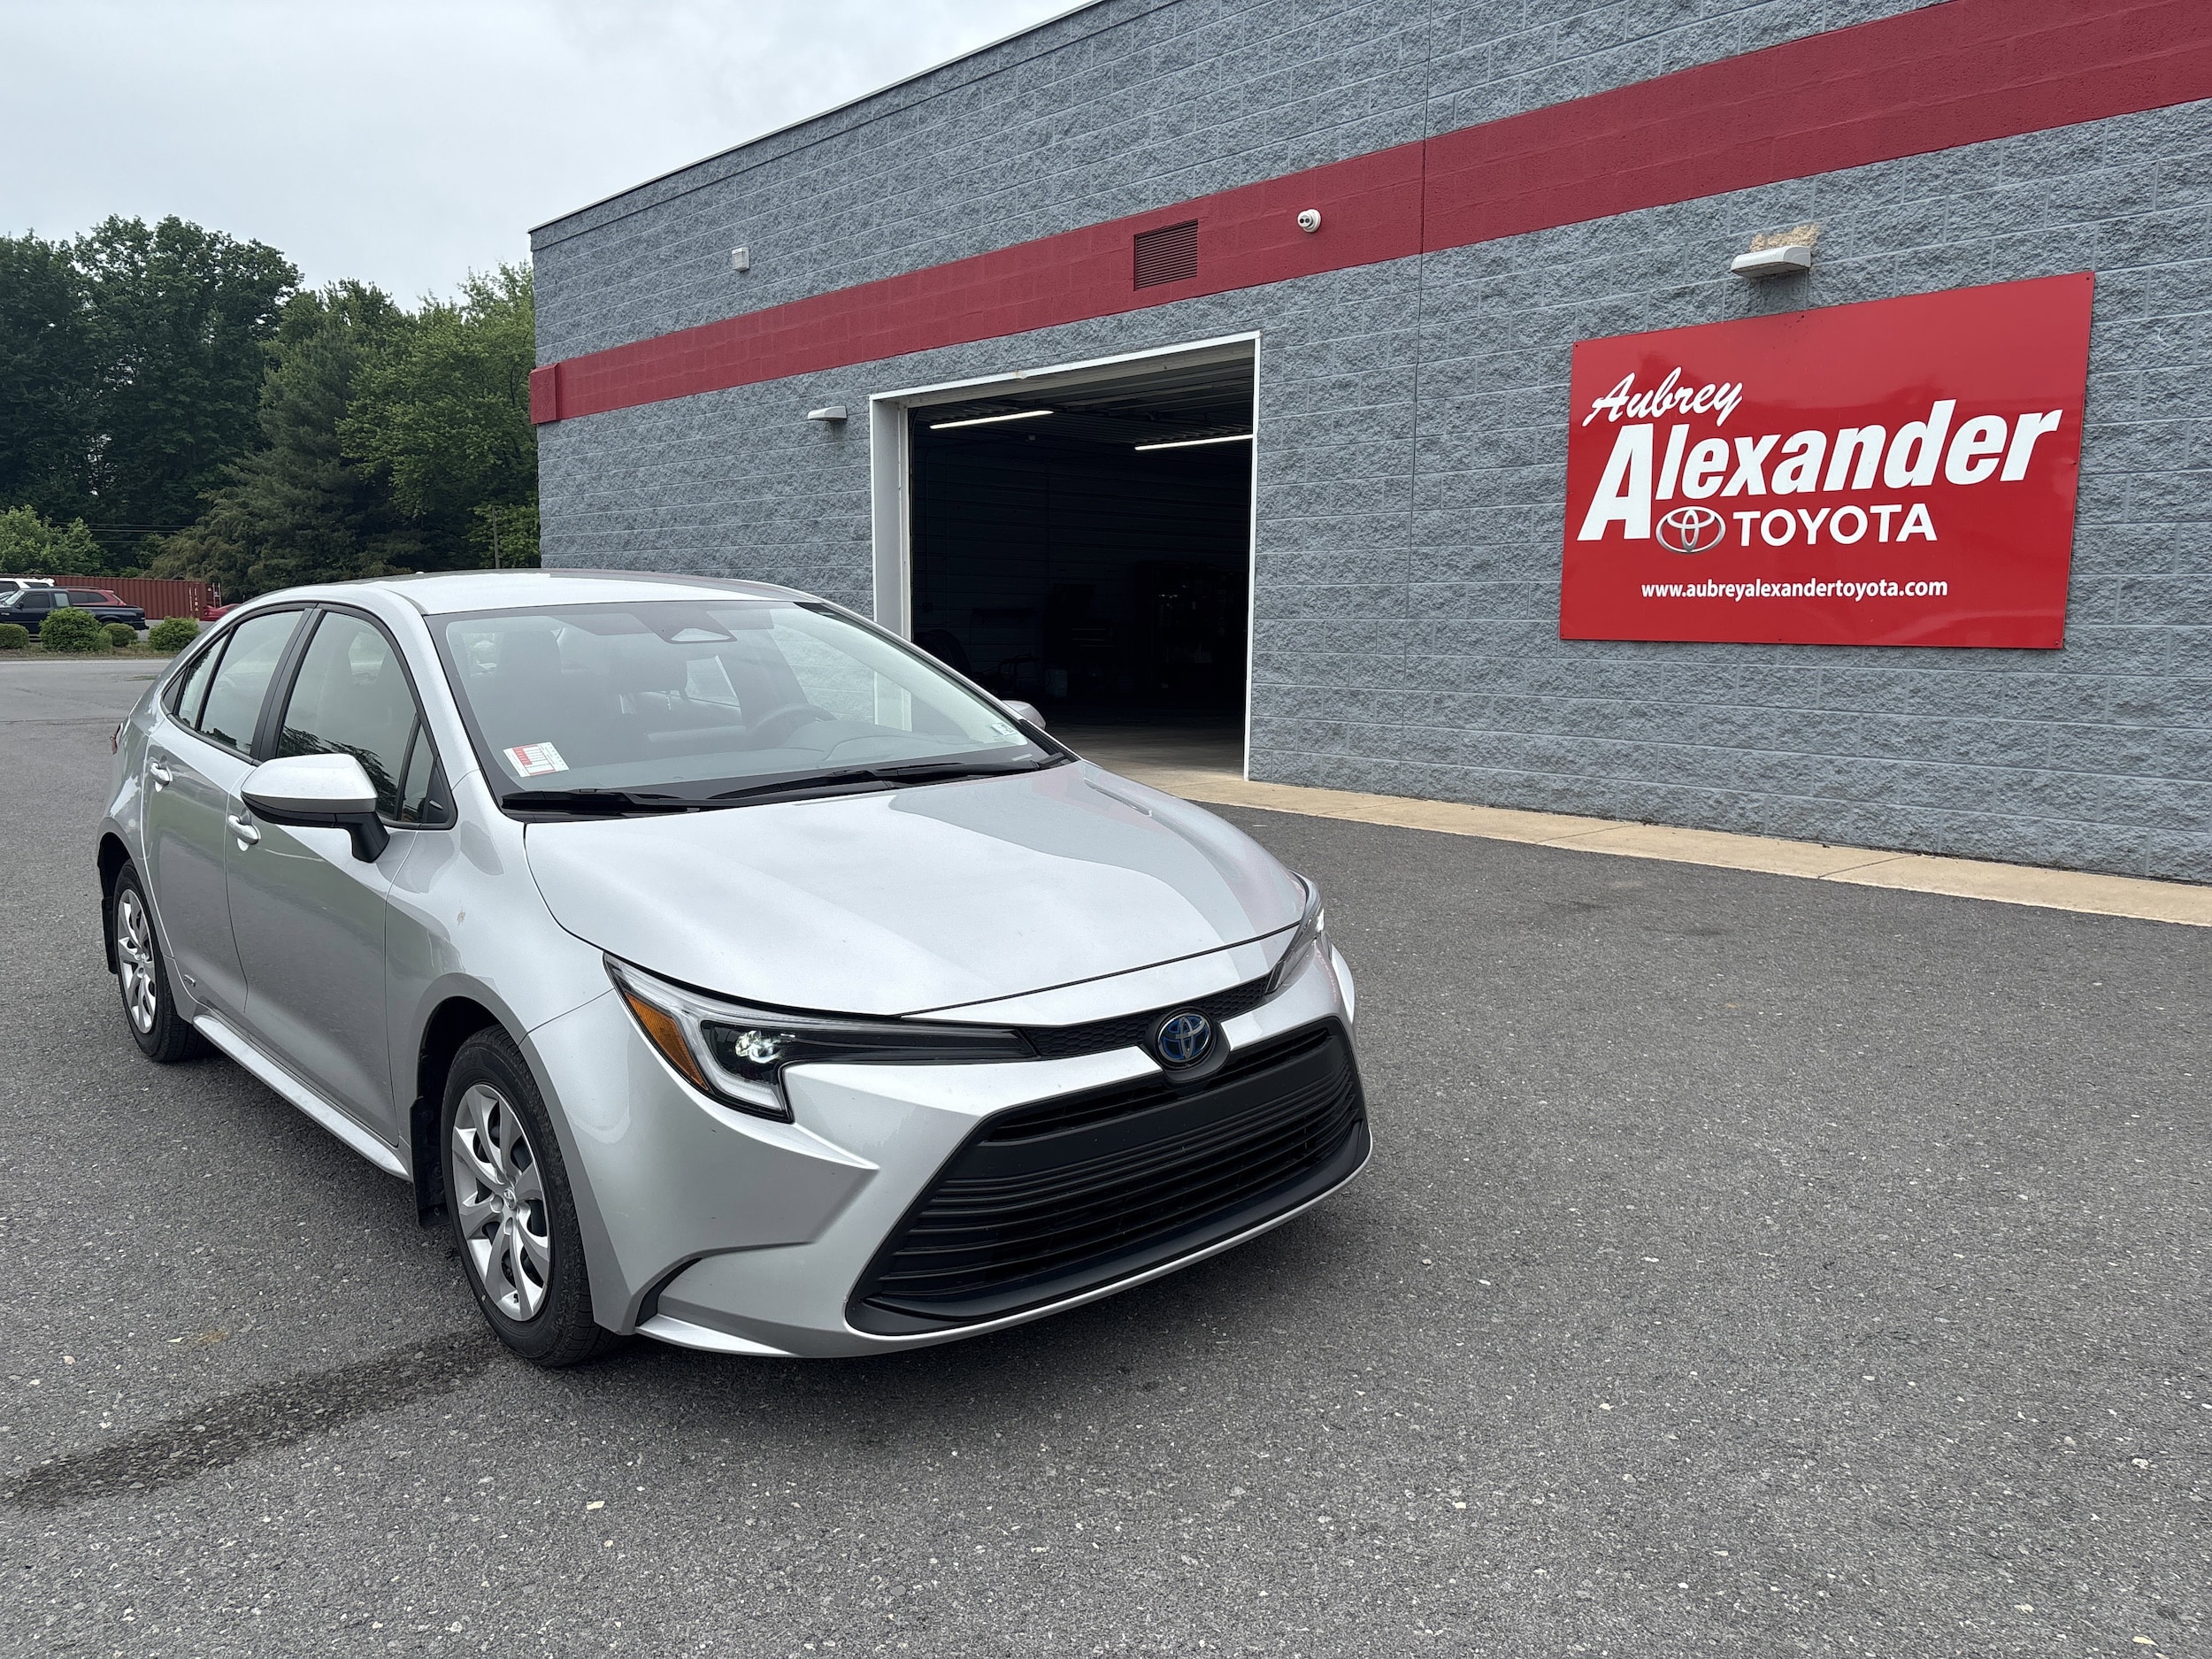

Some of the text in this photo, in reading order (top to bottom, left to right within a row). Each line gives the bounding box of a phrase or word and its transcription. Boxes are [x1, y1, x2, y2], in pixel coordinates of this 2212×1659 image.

[1582, 366, 1743, 427] Aubrey
[1577, 399, 2063, 541] Alexander
[1732, 503, 1938, 547] TOYOTA
[1641, 577, 1948, 603] www.aubreyalexandertoyota.com
